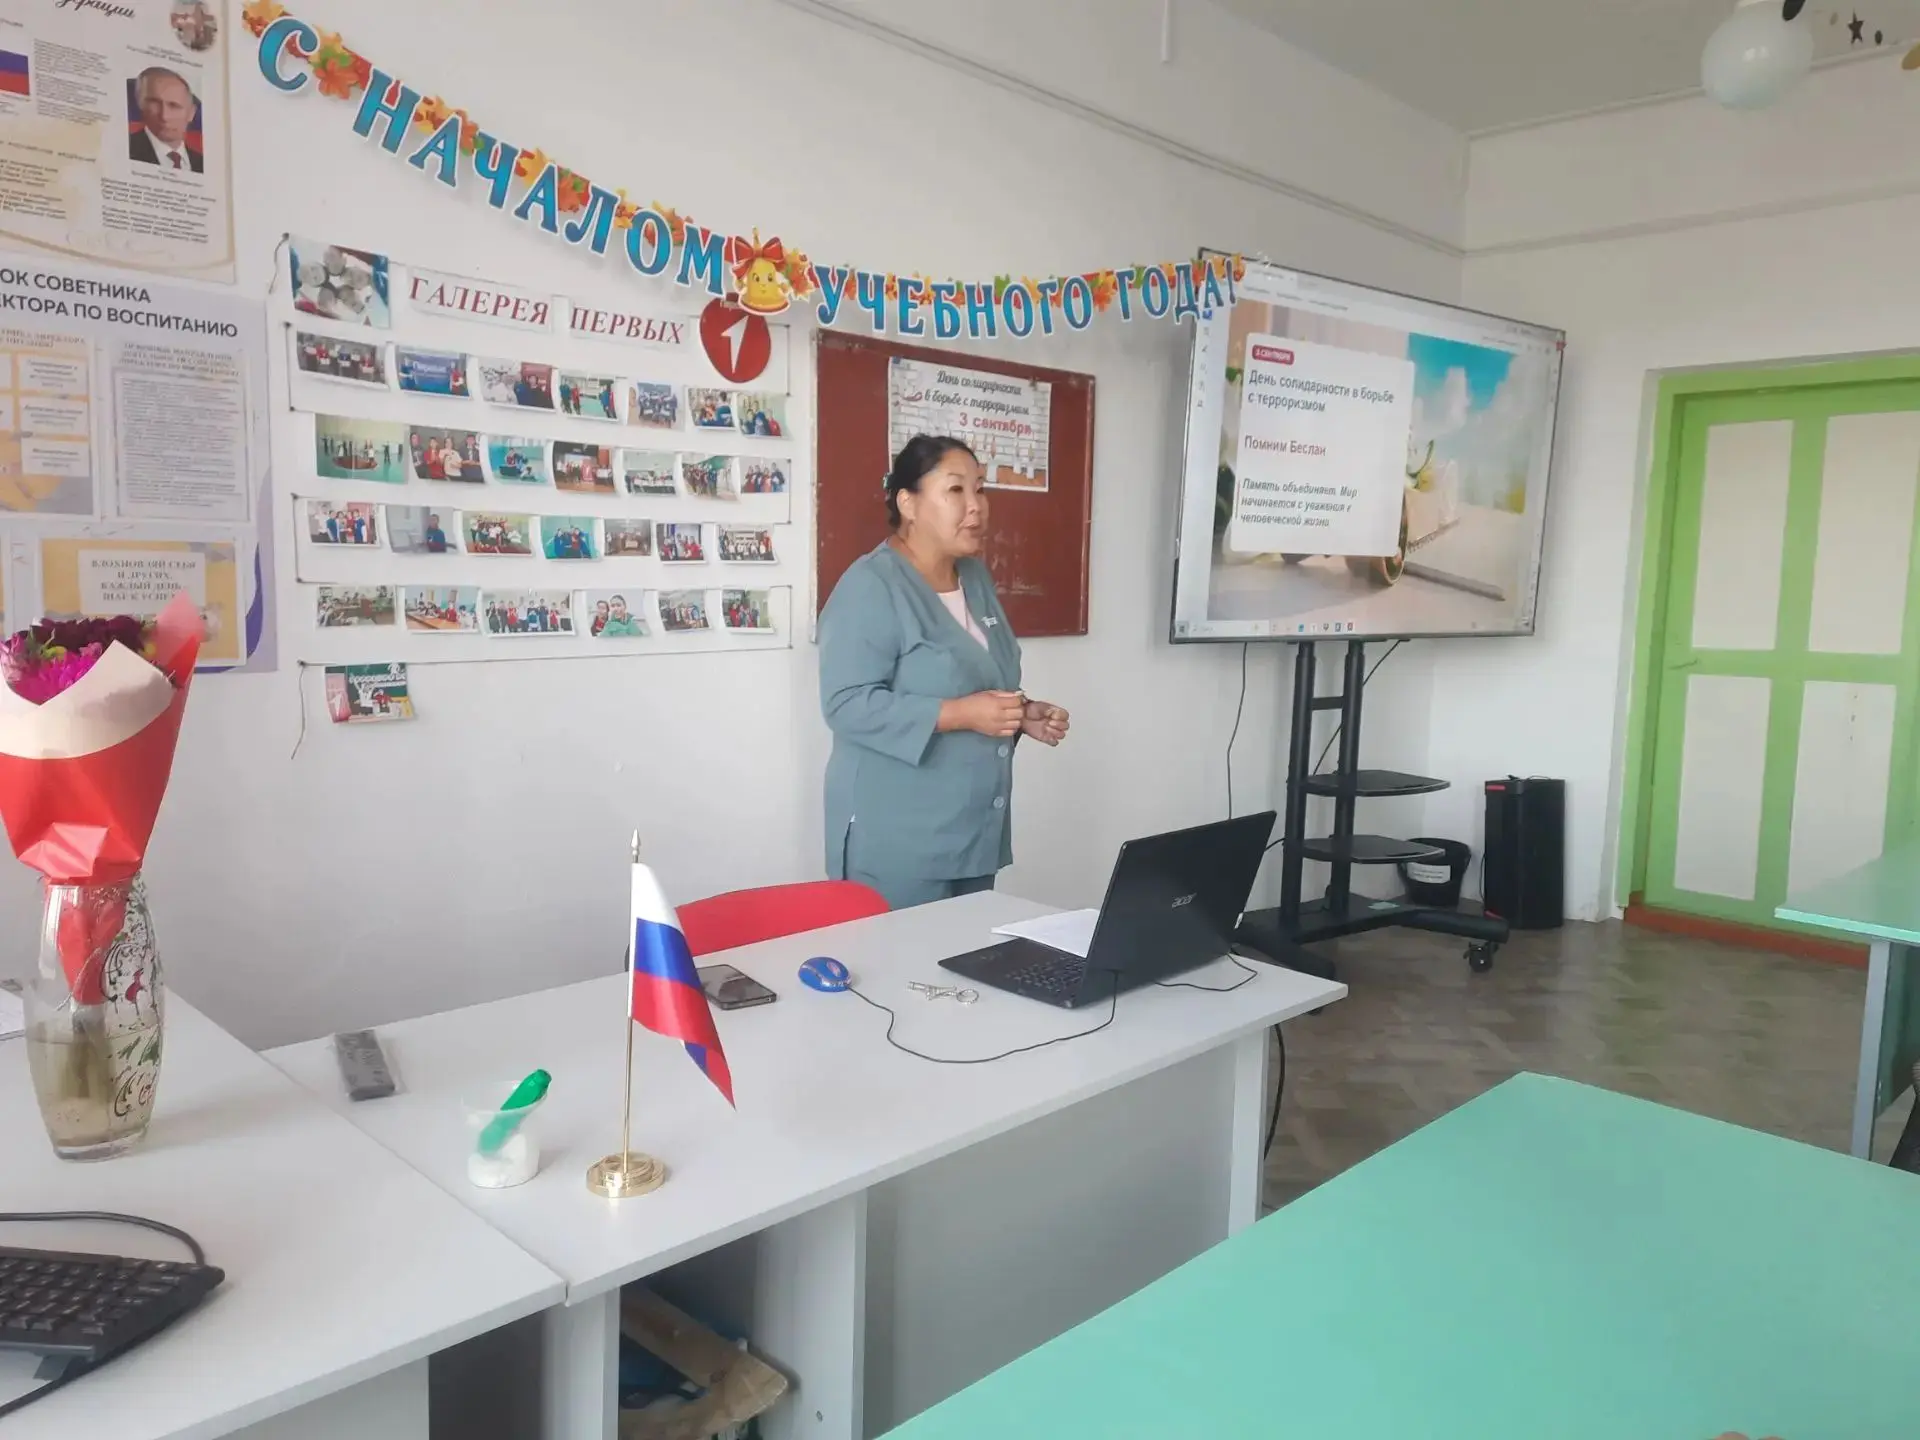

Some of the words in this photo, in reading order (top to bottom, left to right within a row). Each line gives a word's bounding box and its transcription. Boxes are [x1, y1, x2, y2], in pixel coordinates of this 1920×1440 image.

[258, 16, 319, 92] С
[352, 66, 727, 297] НАЧАЛОМ
[34, 273, 152, 303] СОВЕТНИКА
[812, 263, 1095, 341] УЧЕБНОГО
[1115, 257, 1238, 325] ГОДА!
[0, 292, 69, 317] КТОРА
[74, 303, 102, 320] ПО
[107, 307, 238, 338] ВОСПИТАНИЮ
[409, 276, 550, 325] ГАЛЕРЕЯ
[570, 306, 686, 345] ПЕРВЫХ
[936, 370, 959, 386] День
[961, 376, 1022, 396] солидарности
[1249, 369, 1277, 386] День
[1279, 376, 1350, 397] солидарности
[1352, 389, 1358, 397] в
[1360, 387, 1395, 404] борьбе
[924, 389, 930, 399] в
[931, 389, 962, 407] борьбе
[969, 398, 1030, 416] терроризмом
[1248, 392, 1254, 401] с
[1257, 393, 1326, 412] терроризмом
[959, 411, 968, 427] 3
[973, 416, 1032, 436] сентября
[1244, 435, 1287, 453] Помним
[1290, 440, 1327, 456] Беслан
[1242, 478, 1280, 492] Память
[1340, 486, 1358, 499] Мир
[1241, 496, 1296, 510] начинается
[1171, 892, 1198, 910] acer
